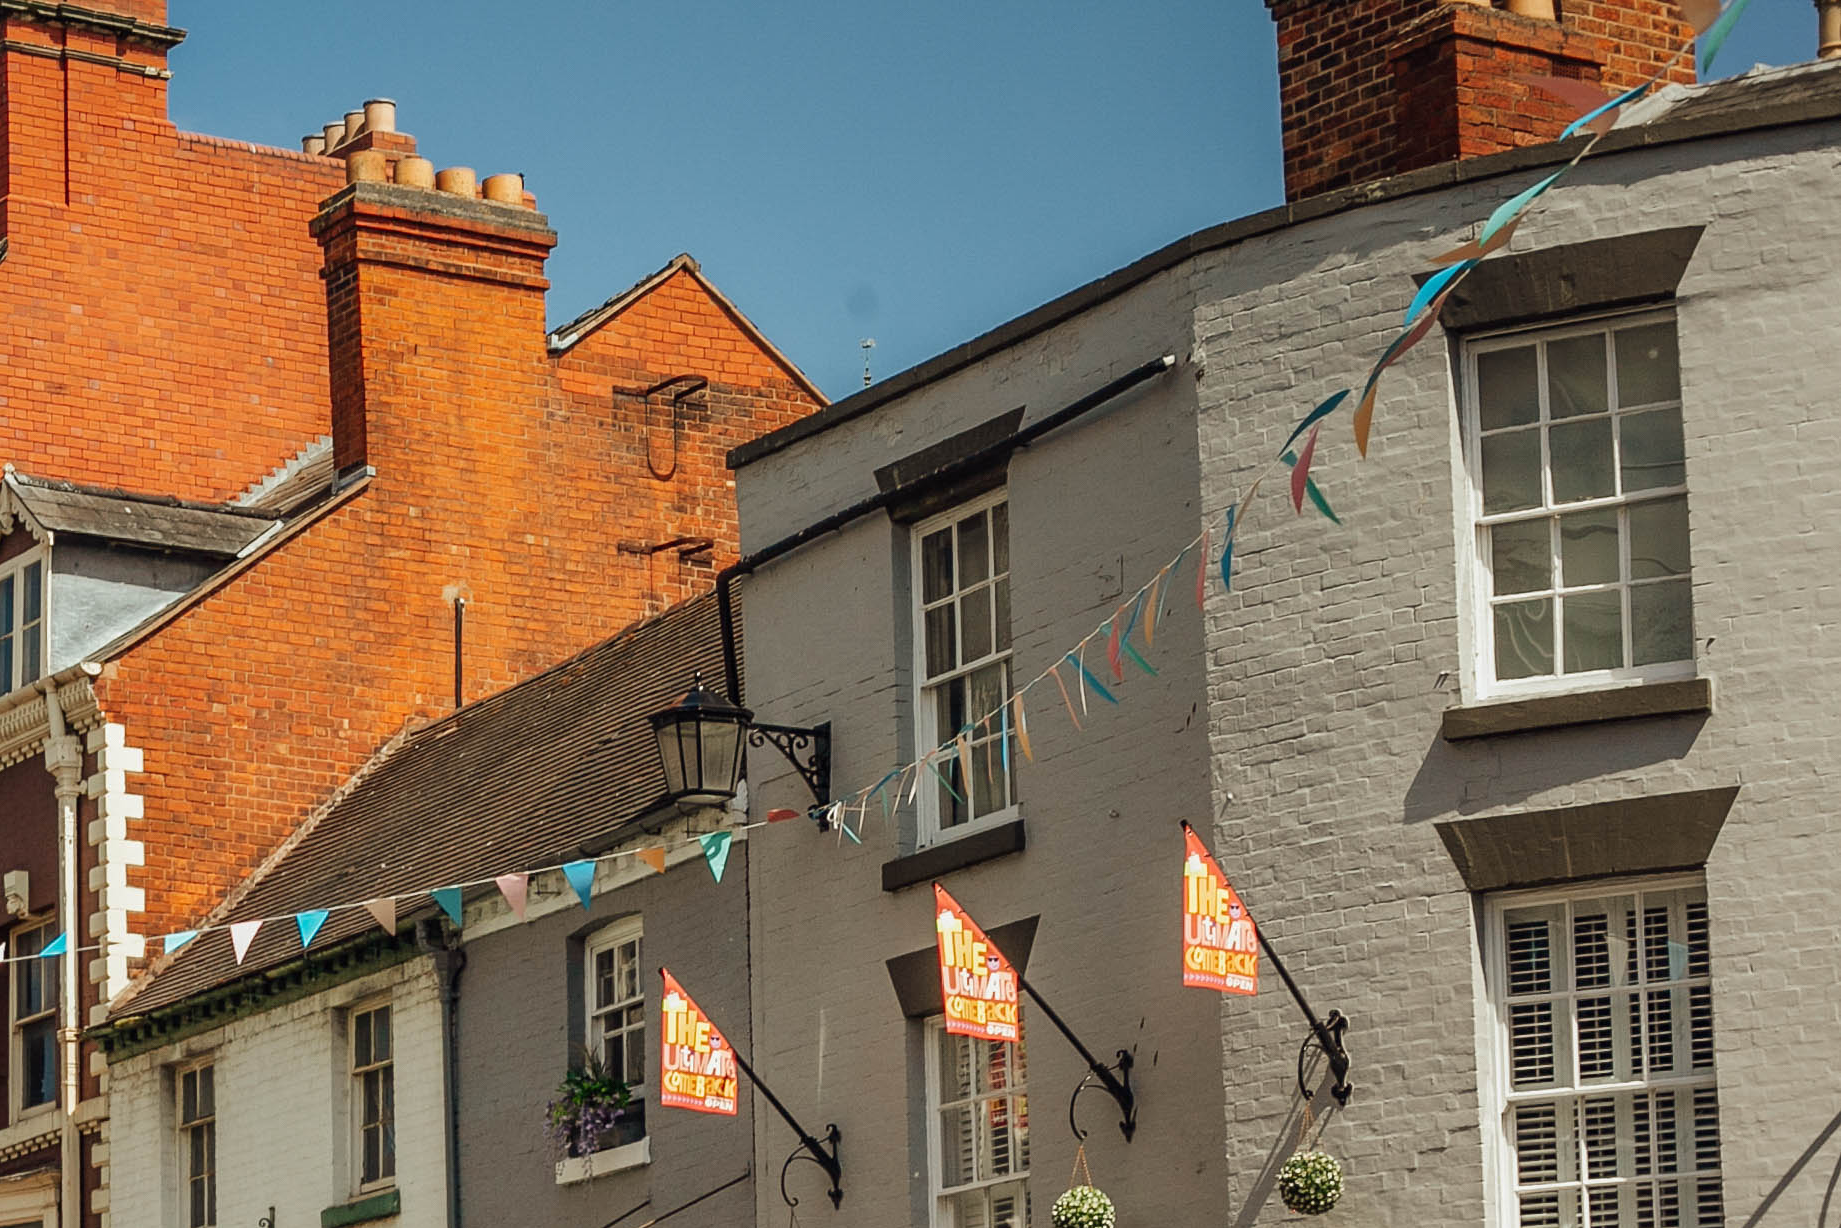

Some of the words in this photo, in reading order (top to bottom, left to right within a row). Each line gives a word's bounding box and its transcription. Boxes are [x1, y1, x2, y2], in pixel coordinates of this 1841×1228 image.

[1184, 860, 1230, 925] THE
[936, 918, 988, 976] THE
[662, 999, 710, 1053] THE
